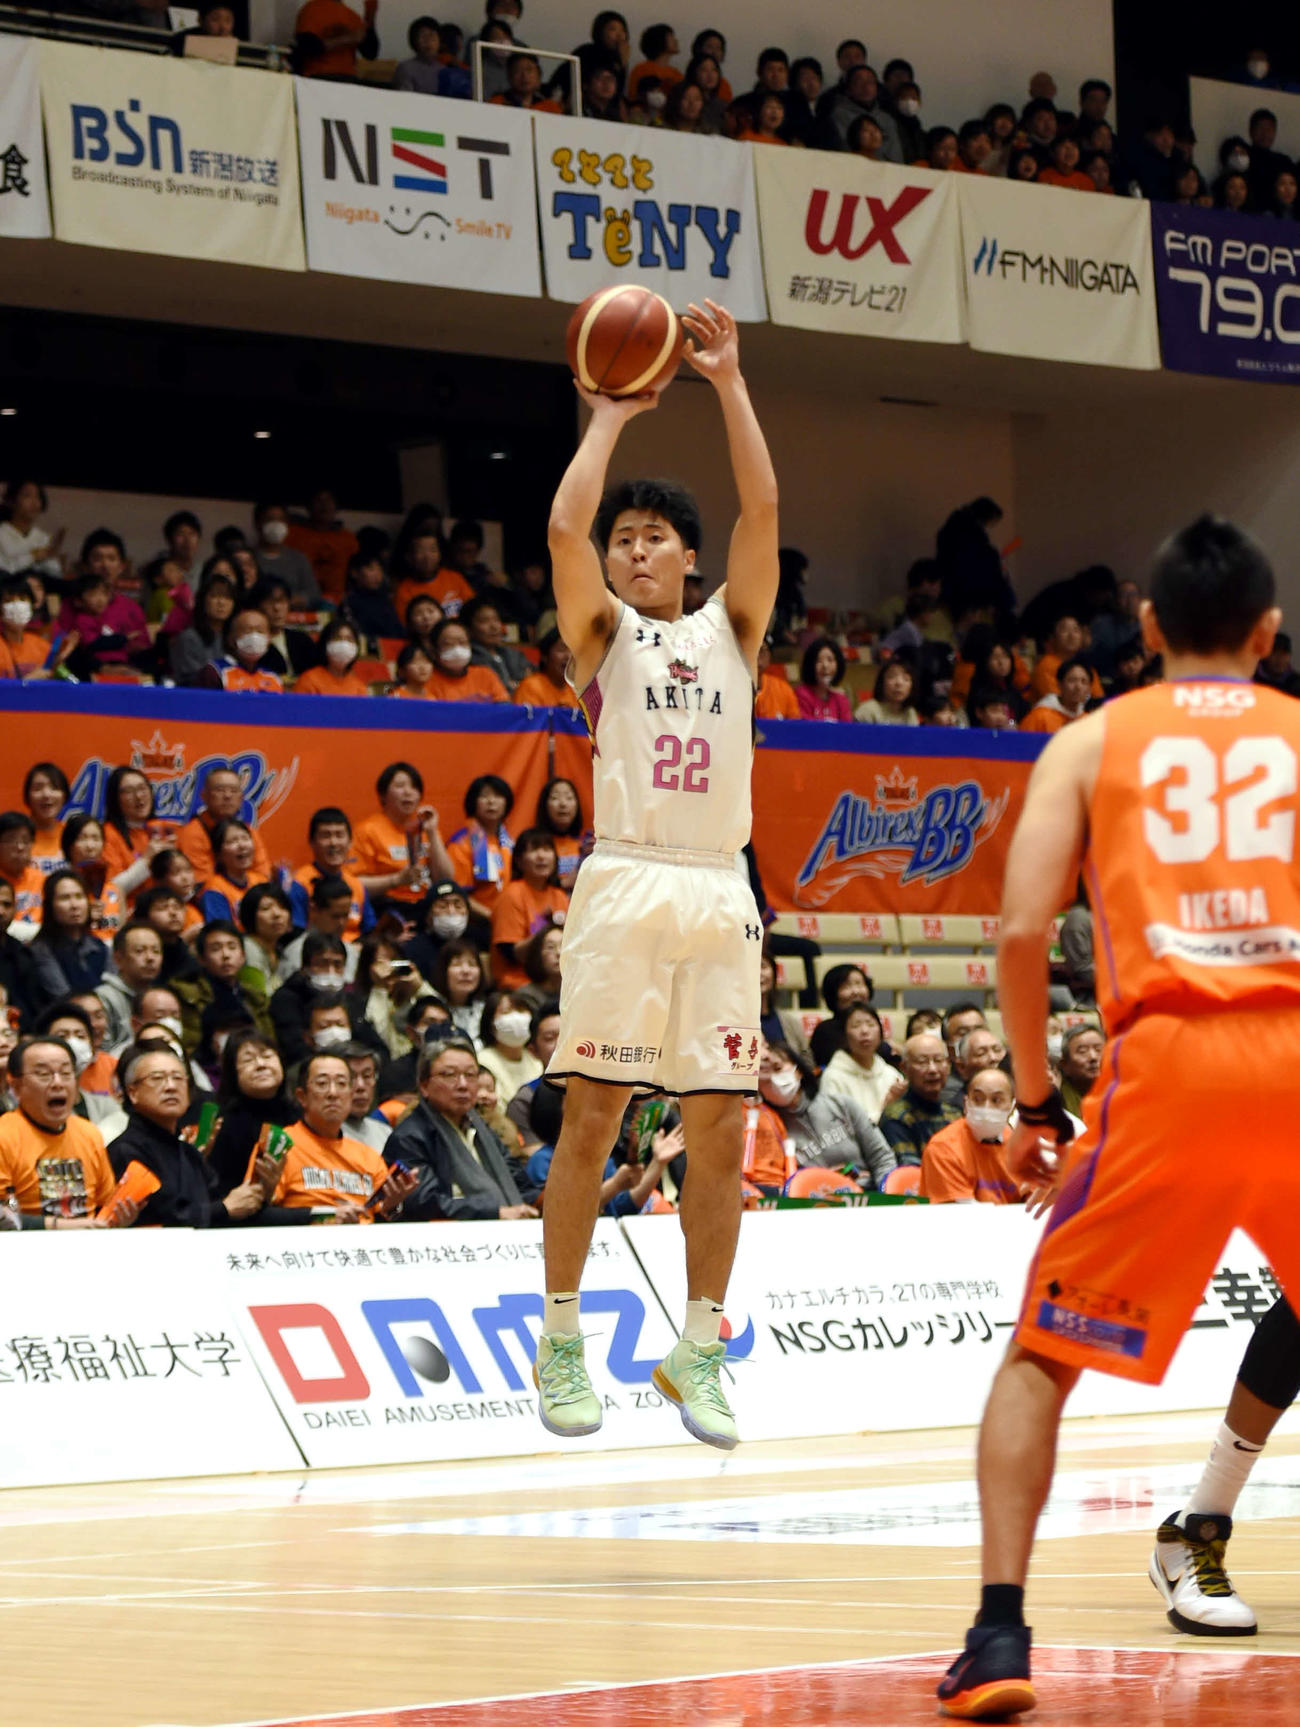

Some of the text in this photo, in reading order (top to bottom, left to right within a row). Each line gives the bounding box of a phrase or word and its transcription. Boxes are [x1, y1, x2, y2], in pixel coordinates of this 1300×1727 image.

[321, 117, 510, 200] NST
[72, 166, 163, 194] Broadcasting
[165, 179, 214, 200] System
[217, 186, 231, 199] of
[325, 200, 513, 240] Niigata Smile TV
[553, 191, 741, 279] TeNY
[1164, 229, 1212, 267] FM
[790, 275, 907, 313] 新潟テレビ21
[646, 686, 722, 714] AKITA
[1173, 686, 1257, 707] NSG
[653, 734, 710, 793] 22
[1140, 736, 1298, 864] 32
[1180, 887, 1269, 930] IKEDA
[1174, 938, 1232, 956] onda
[1238, 939, 1282, 956] Cars
[600, 1044, 657, 1064] 秋田銀行
[303, 1409, 371, 1429] DAIEI
[385, 1399, 535, 1425] AMUSEMENT
